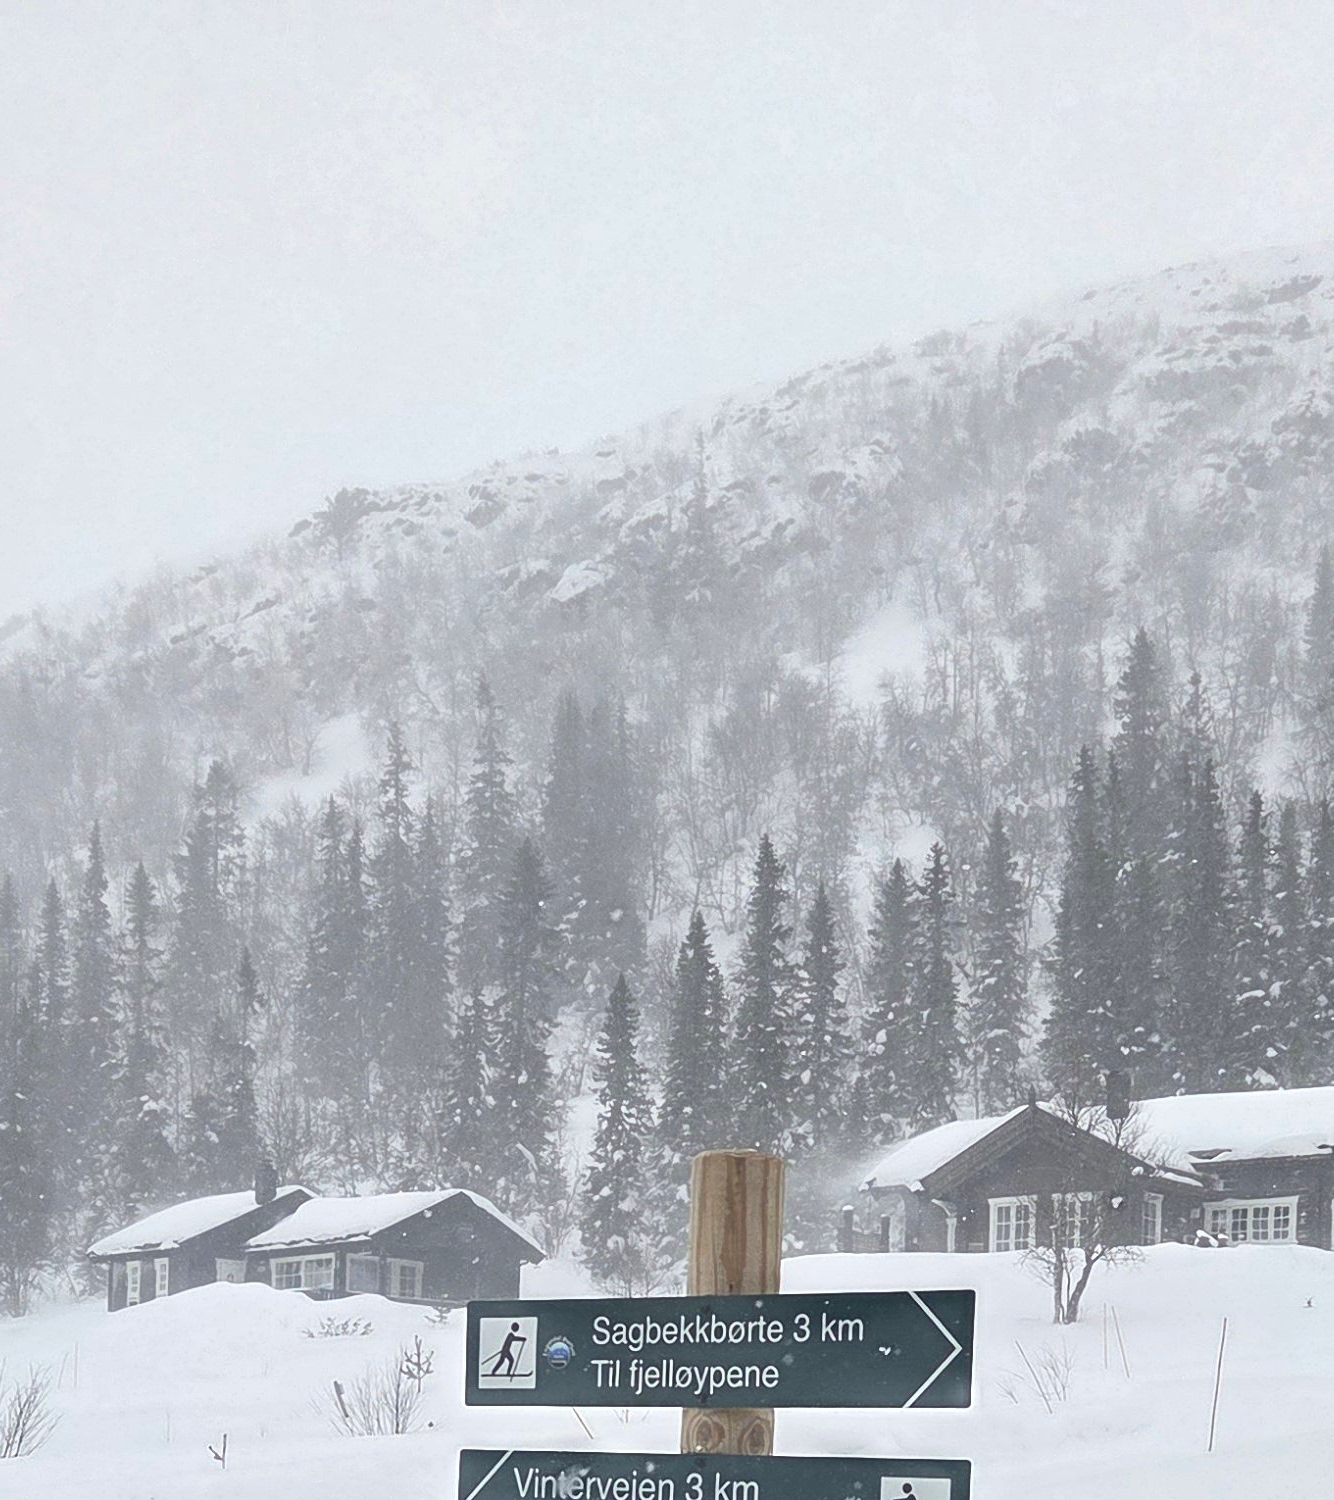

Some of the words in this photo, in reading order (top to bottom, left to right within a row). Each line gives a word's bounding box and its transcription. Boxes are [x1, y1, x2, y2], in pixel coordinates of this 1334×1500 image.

[592, 1315, 783, 1352] Sagbekkbørte
[793, 1315, 810, 1341] 3
[822, 1314, 864, 1341] km
[591, 1360, 620, 1387] Til
[629, 1359, 779, 1395] fjelløypene
